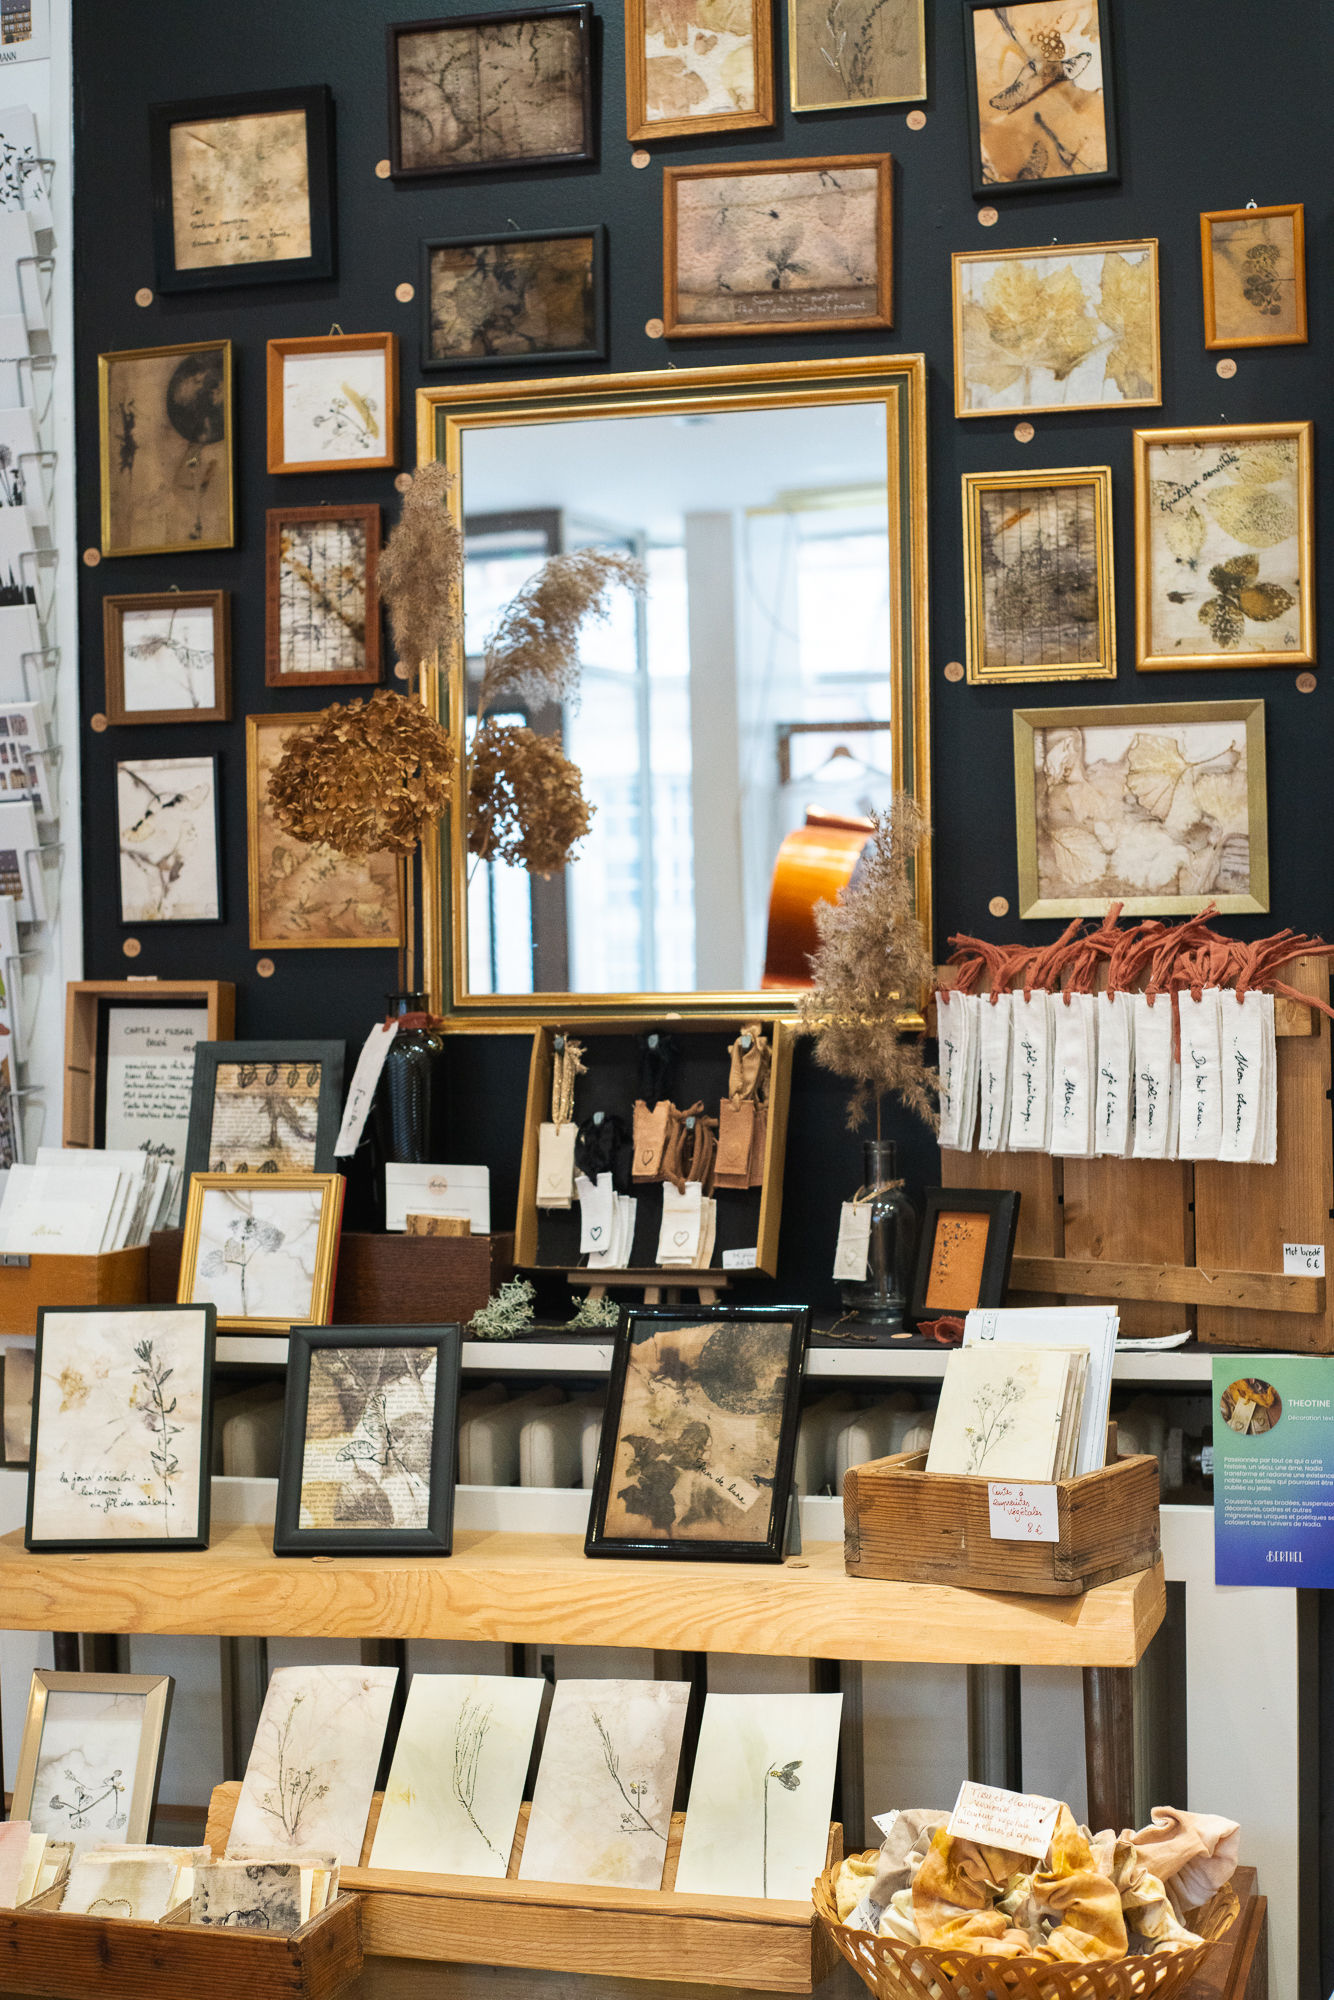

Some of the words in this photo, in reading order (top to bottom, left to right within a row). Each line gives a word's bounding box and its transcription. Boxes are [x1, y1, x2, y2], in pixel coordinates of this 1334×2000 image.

[1285, 1246, 1298, 1256] Mot
[1301, 1246, 1321, 1256] brodé
[1288, 1399, 1331, 1408] THEOTINE
[78, 1485, 122, 1496] lentement
[715, 1476, 725, 1487] de
[727, 1483, 745, 1505] lune
[992, 1484, 1013, 1496] Cartes
[1019, 1487, 1024, 1496] à
[992, 1497, 1030, 1511] empreintes
[1007, 1506, 1042, 1523] végétales
[1296, 1513, 1326, 1521] poétiques
[971, 1787, 992, 1799] Tissu
[993, 1792, 1005, 1803] et
[962, 1806, 994, 1821] Teinture
